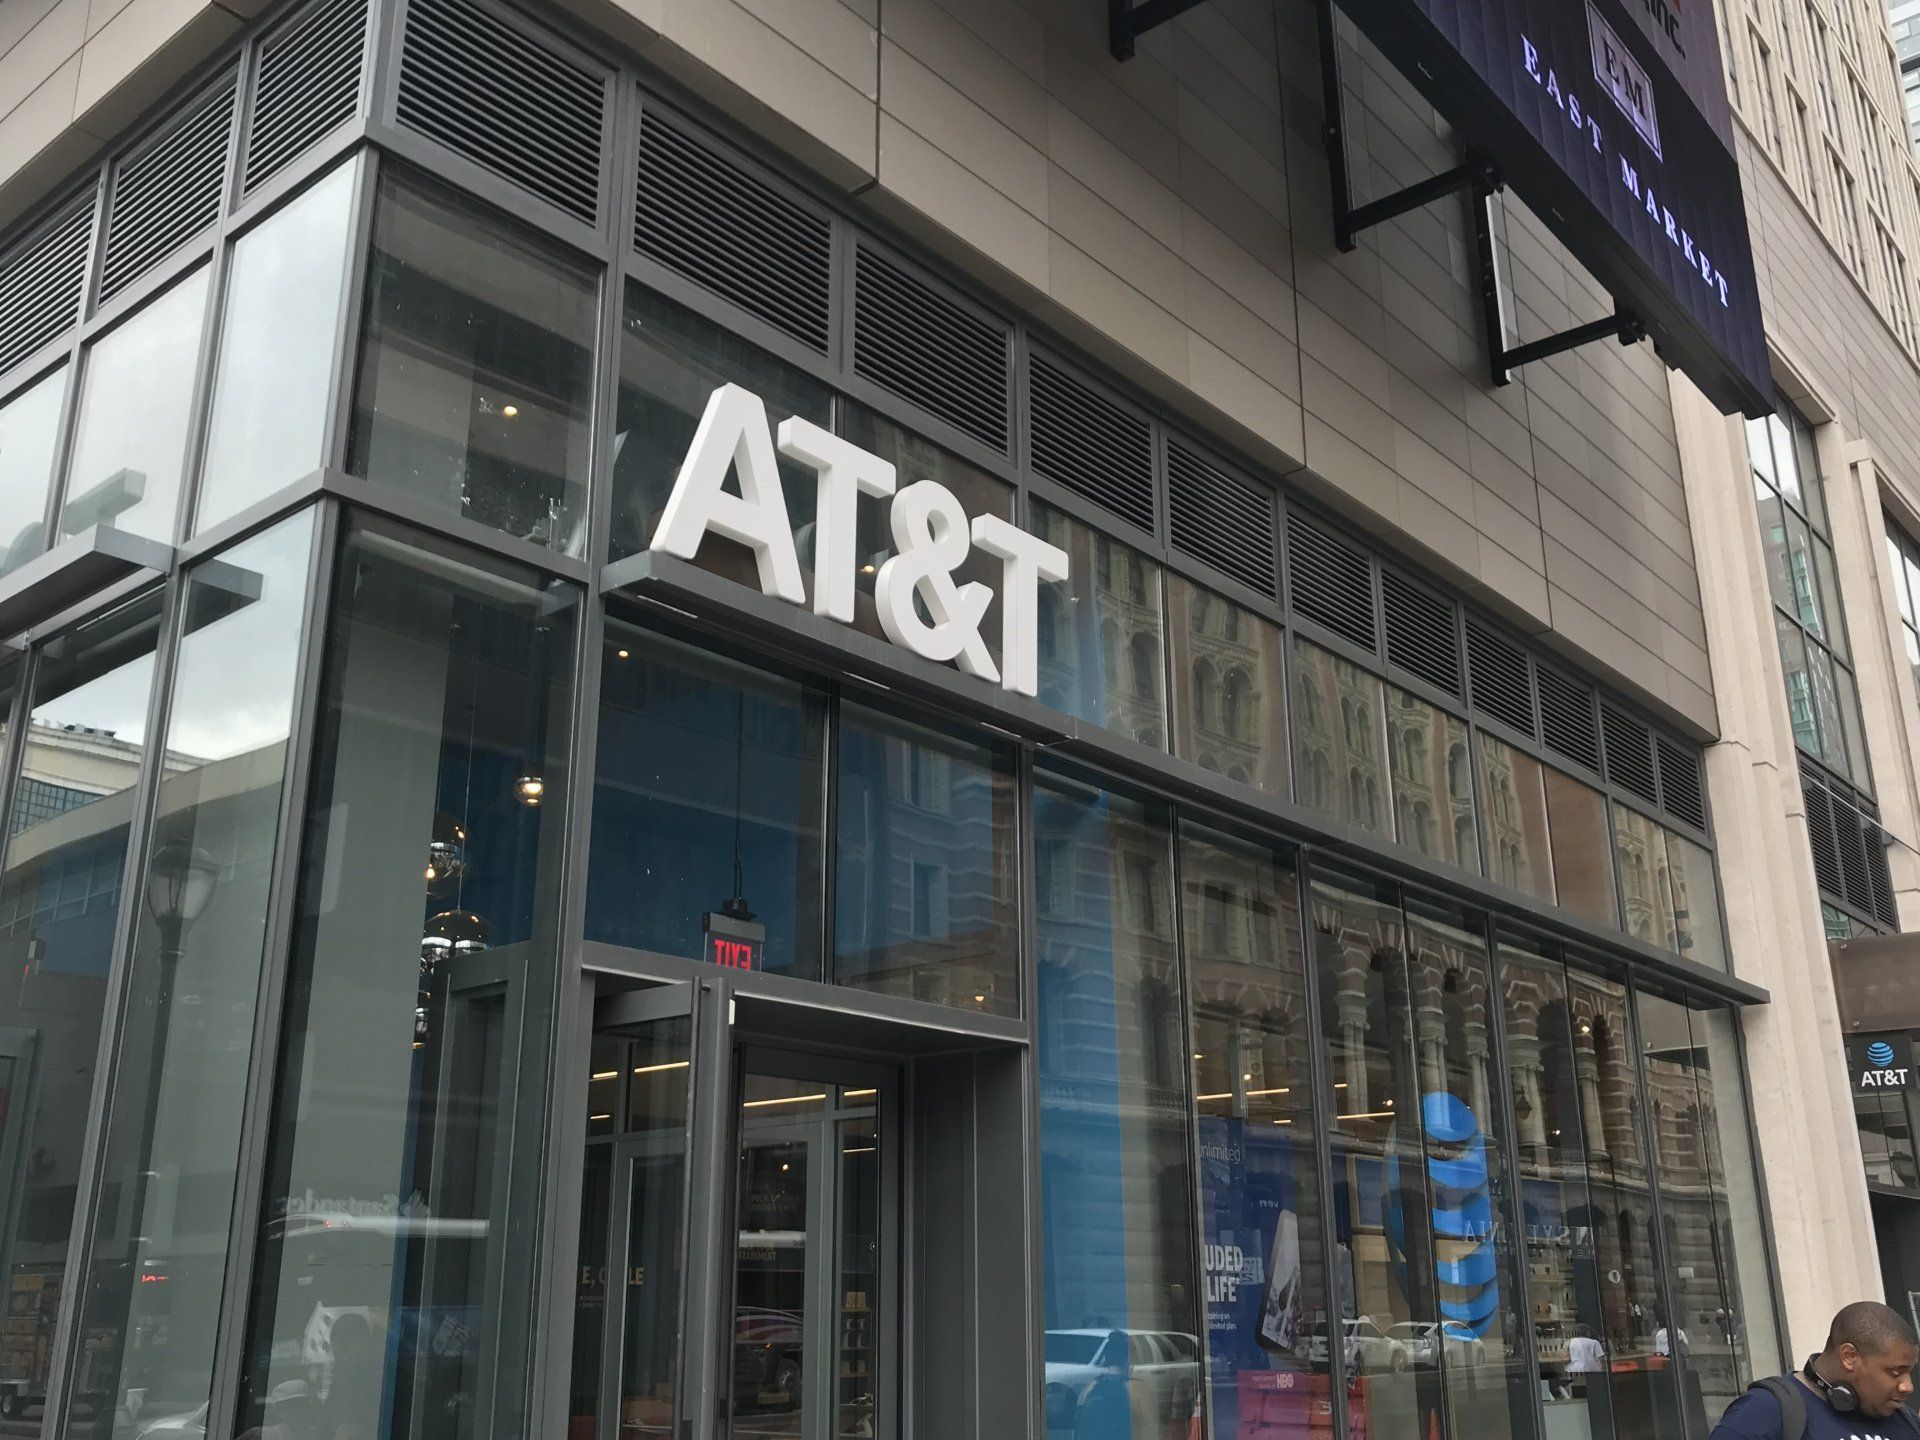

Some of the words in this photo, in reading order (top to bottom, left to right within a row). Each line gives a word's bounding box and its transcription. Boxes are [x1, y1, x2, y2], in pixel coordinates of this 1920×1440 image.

[1601, 36, 1648, 121] EM
[1520, 33, 1602, 154] EAST
[1618, 152, 1729, 307] MARKET
[649, 382, 1069, 697] AT&T
[1861, 1068, 1909, 1087] AT&T
[1204, 1244, 1244, 1272] UDED
[1276, 1373, 1294, 1389] HBO
